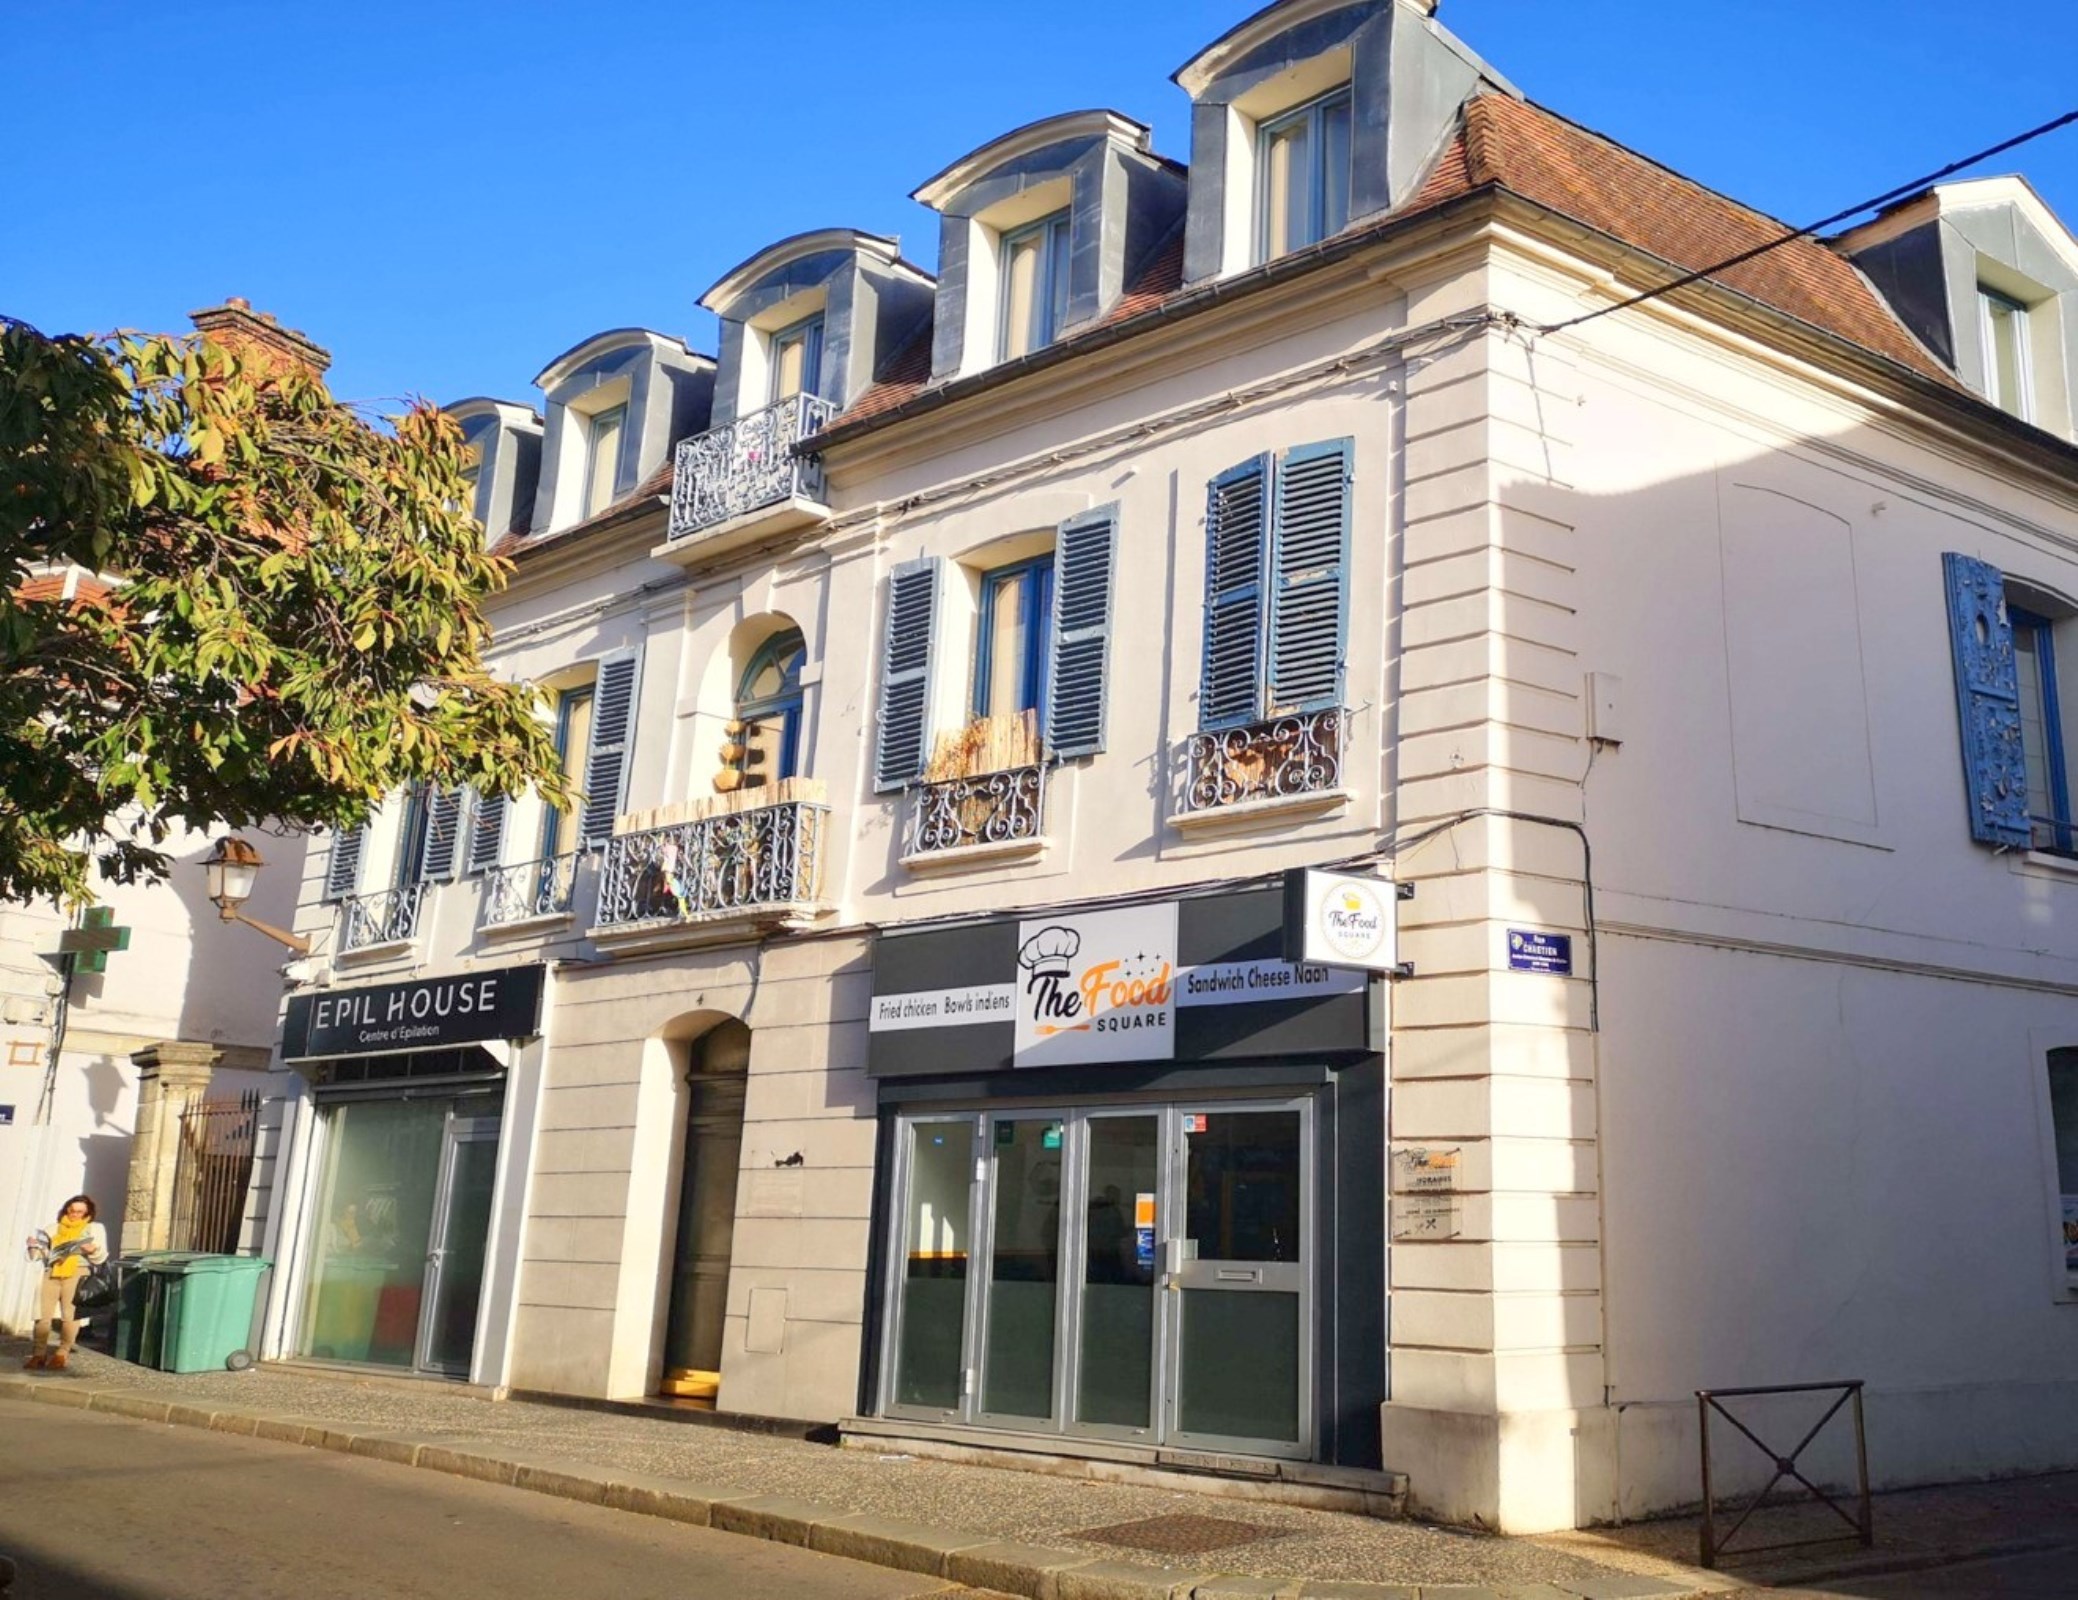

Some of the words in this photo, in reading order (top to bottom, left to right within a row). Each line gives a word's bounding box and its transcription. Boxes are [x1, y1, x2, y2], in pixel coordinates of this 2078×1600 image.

[1328, 911, 1346, 928] The
[1347, 912, 1378, 929] Food
[1027, 970, 1082, 1022] The
[1080, 960, 1171, 1017] Food
[1187, 969, 1244, 994] Sandwich
[1248, 965, 1290, 988] Cheese
[1294, 964, 1329, 984] Naan
[315, 995, 376, 1029] EPIL
[386, 979, 497, 1022] HOUSE
[879, 999, 901, 1020] Fried
[903, 997, 938, 1018] chicken
[944, 995, 972, 1014] Bowls
[1097, 1012, 1167, 1032] SQUARE
[359, 1029, 388, 1043] Centre
